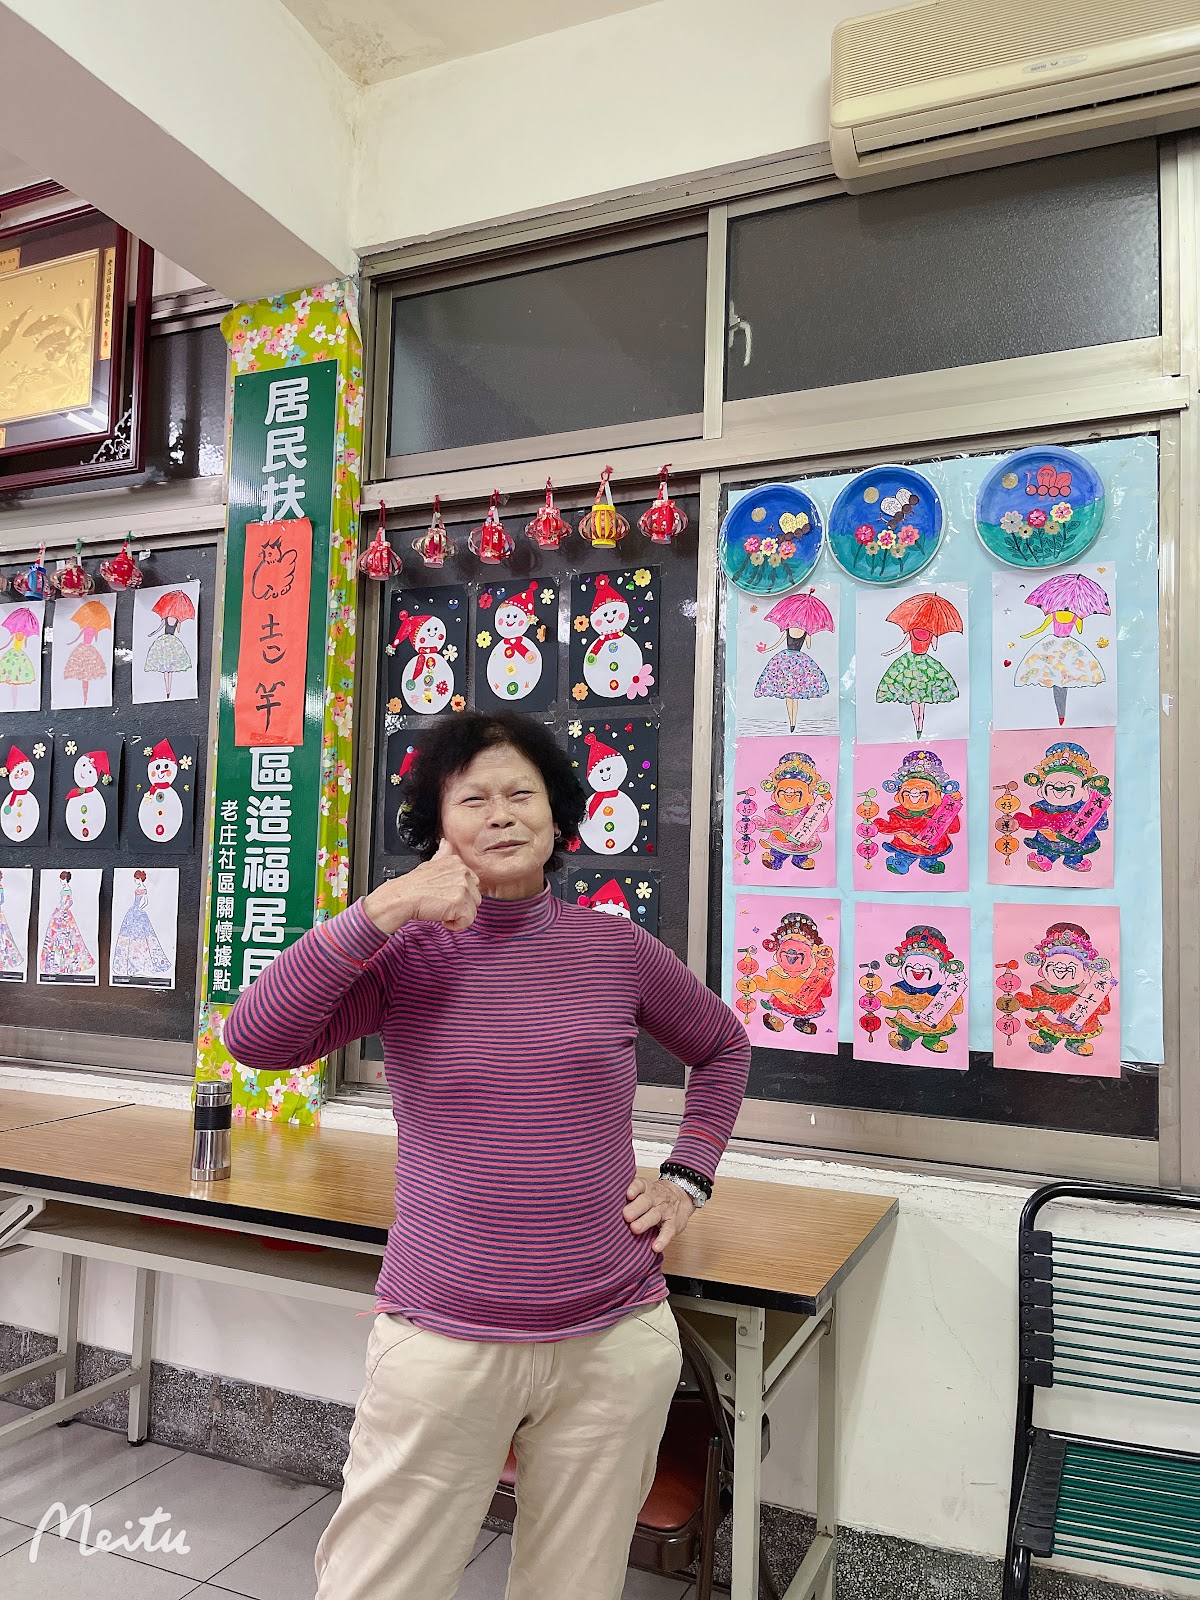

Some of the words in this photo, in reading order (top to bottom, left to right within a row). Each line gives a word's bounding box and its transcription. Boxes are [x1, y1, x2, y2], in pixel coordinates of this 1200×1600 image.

[262, 377, 309, 521] 居民扶
[1000, 801, 1014, 851] 好運來
[1066, 797, 1105, 839] 恭喜發財
[213, 800, 239, 992] 老庄社區關懷據點
